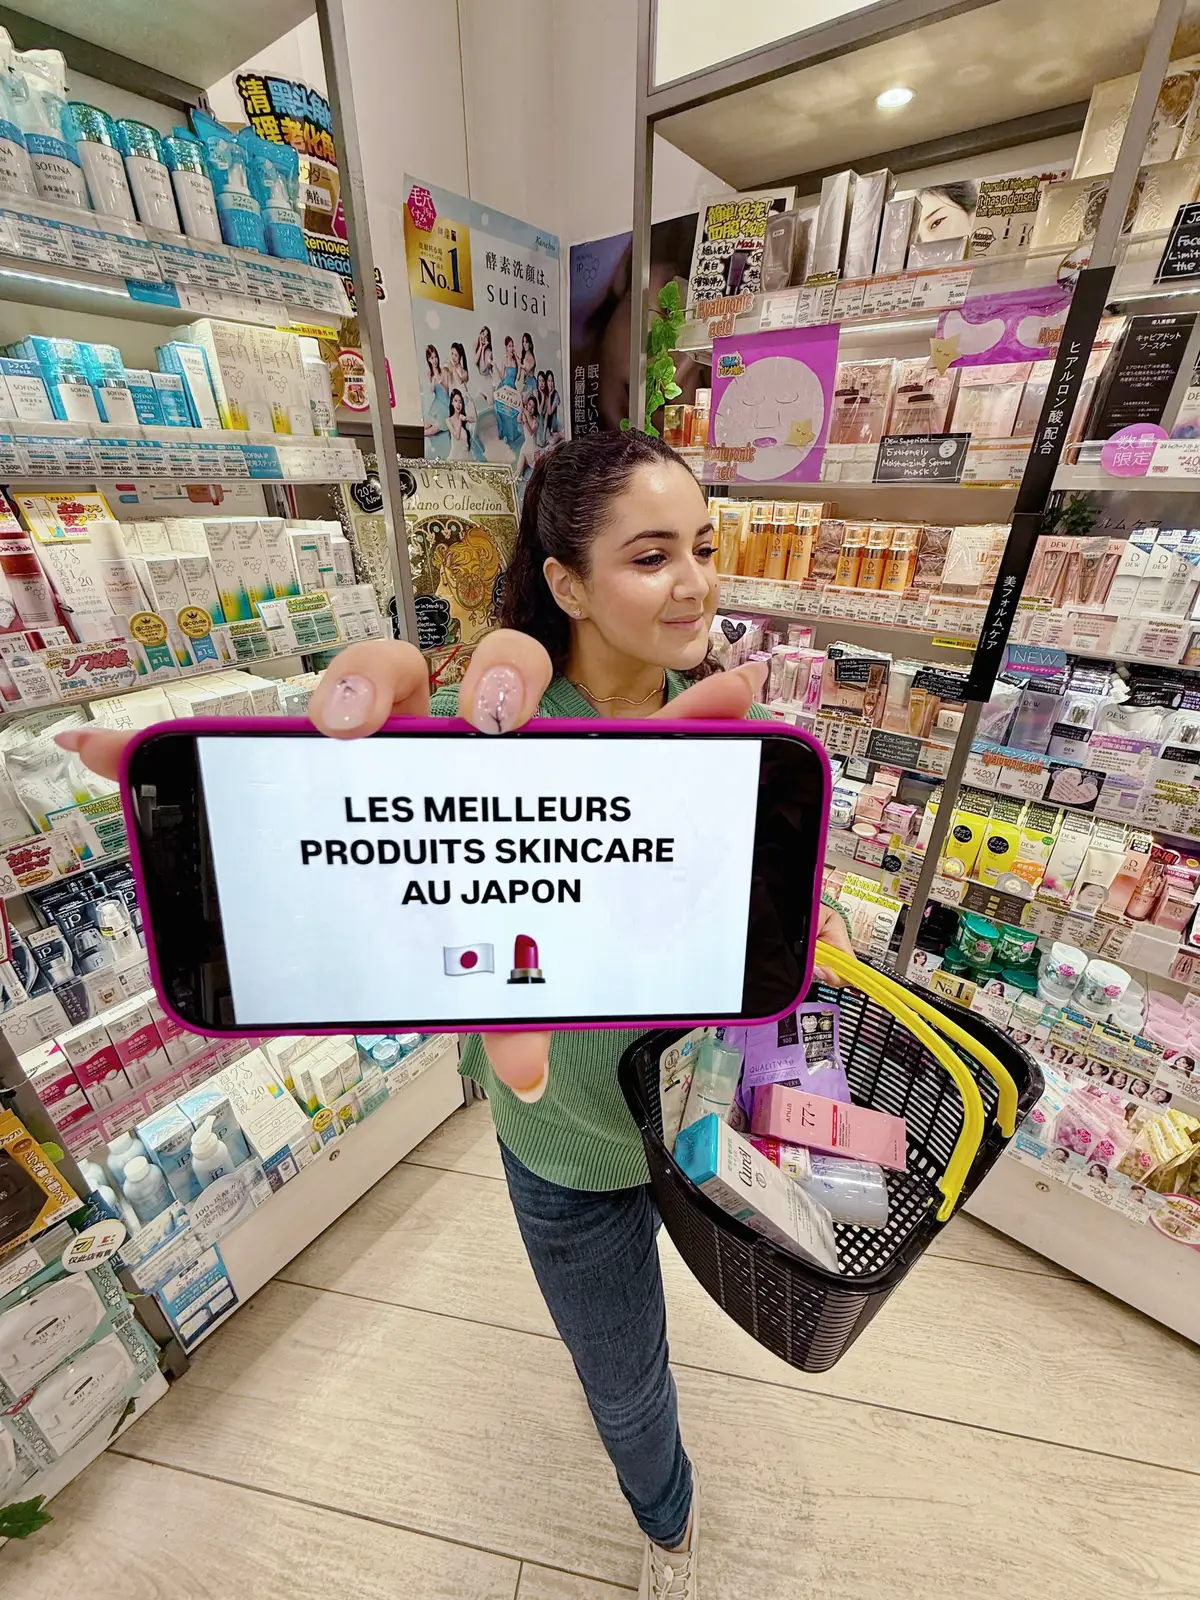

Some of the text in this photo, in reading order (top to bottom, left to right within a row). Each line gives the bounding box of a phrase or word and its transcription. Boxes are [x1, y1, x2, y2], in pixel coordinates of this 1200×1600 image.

[35, 161, 73, 176] SOFINA
[411, 187, 433, 210] 毛穴
[304, 234, 350, 257] Removes
[486, 284, 546, 317] suisai
[7, 362, 31, 371] レフィル
[13, 384, 41, 392] SOFINA
[587, 364, 599, 434] 眠っている
[1116, 432, 1156, 450] 数量
[886, 447, 930, 458] Extremely
[1112, 451, 1153, 467] 限定
[903, 468, 930, 476] mask
[442, 494, 503, 512] Collection
[135, 623, 162, 633] @cosme
[182, 619, 207, 628] @cosme
[62, 648, 130, 677] シワ改善
[1013, 650, 1060, 665] NEW
[1106, 710, 1128, 721] DEW
[344, 796, 632, 823] LES MEILLEURS
[300, 837, 675, 866] PRODUITS SKINCARE
[401, 878, 582, 905] AU JAPON
[59, 908, 80, 918] SOFINA
[62, 913, 82, 930] iP
[38, 945, 52, 959] iP
[116, 1015, 144, 1033] SOFINA
[73, 1037, 104, 1056] SOFINA
[749, 1061, 783, 1074] QUALITY
[176, 1152, 192, 1169] iP
[210, 1164, 225, 1181] iP
